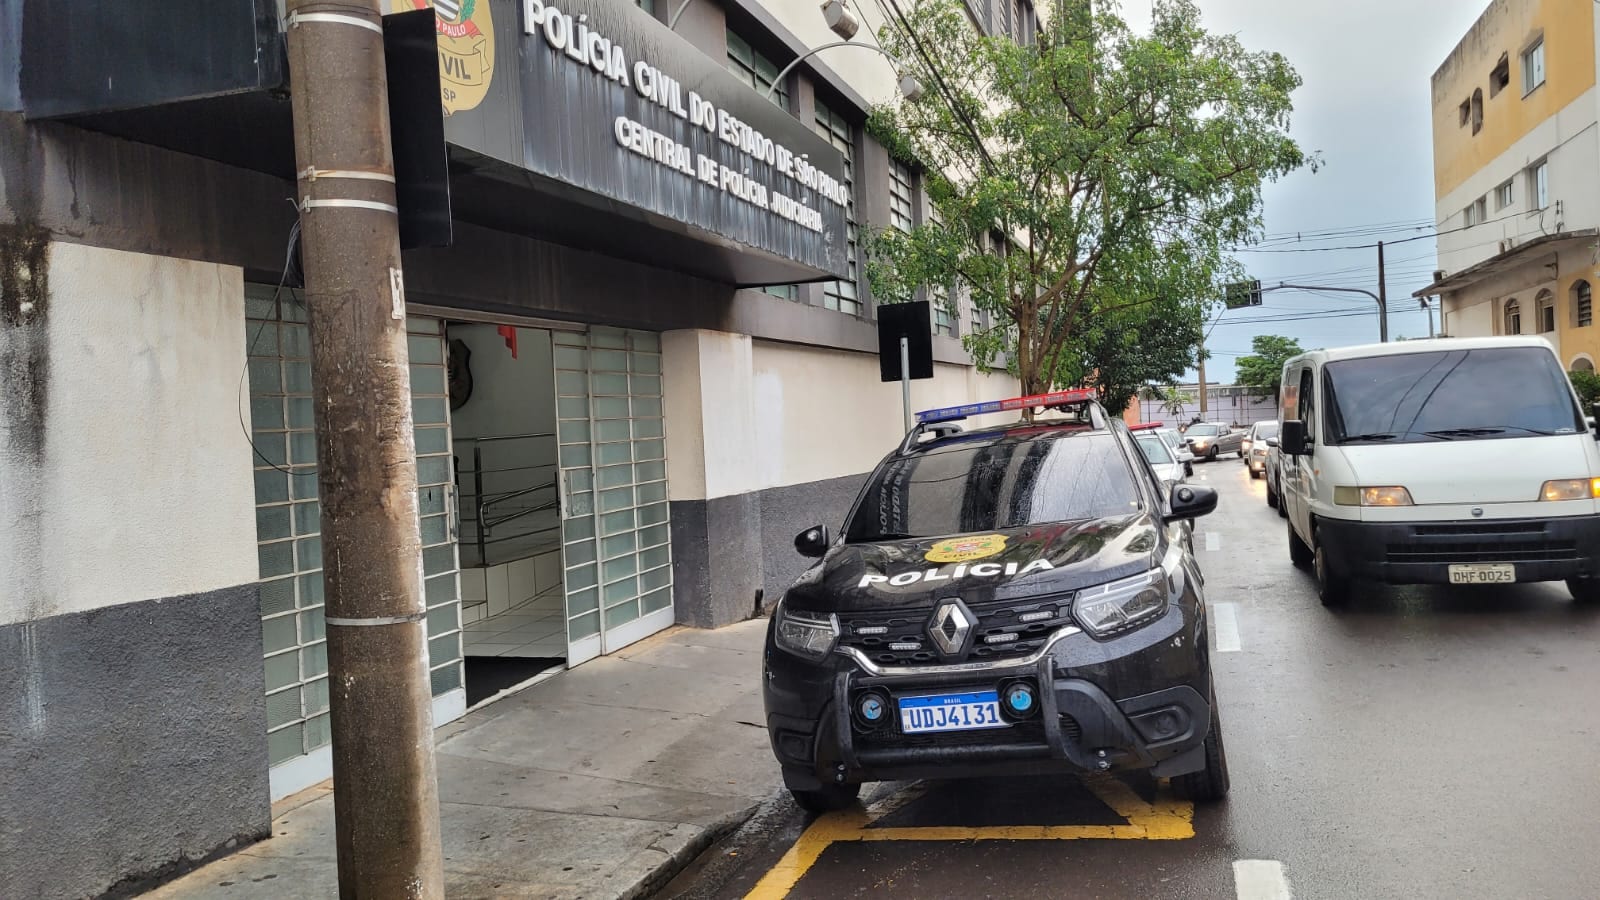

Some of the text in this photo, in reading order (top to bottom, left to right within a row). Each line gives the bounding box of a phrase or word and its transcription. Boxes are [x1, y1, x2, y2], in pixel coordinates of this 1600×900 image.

[442, 23, 466, 37] PAULO
[441, 52, 471, 80] VIL
[443, 87, 456, 102] SP
[524, 0, 848, 208] POLÍCIA CIVIL DO ESTADO DE SÃO PAULO
[614, 116, 823, 233] CENTRAL DE POLÍCIA JUDICIÁRIA
